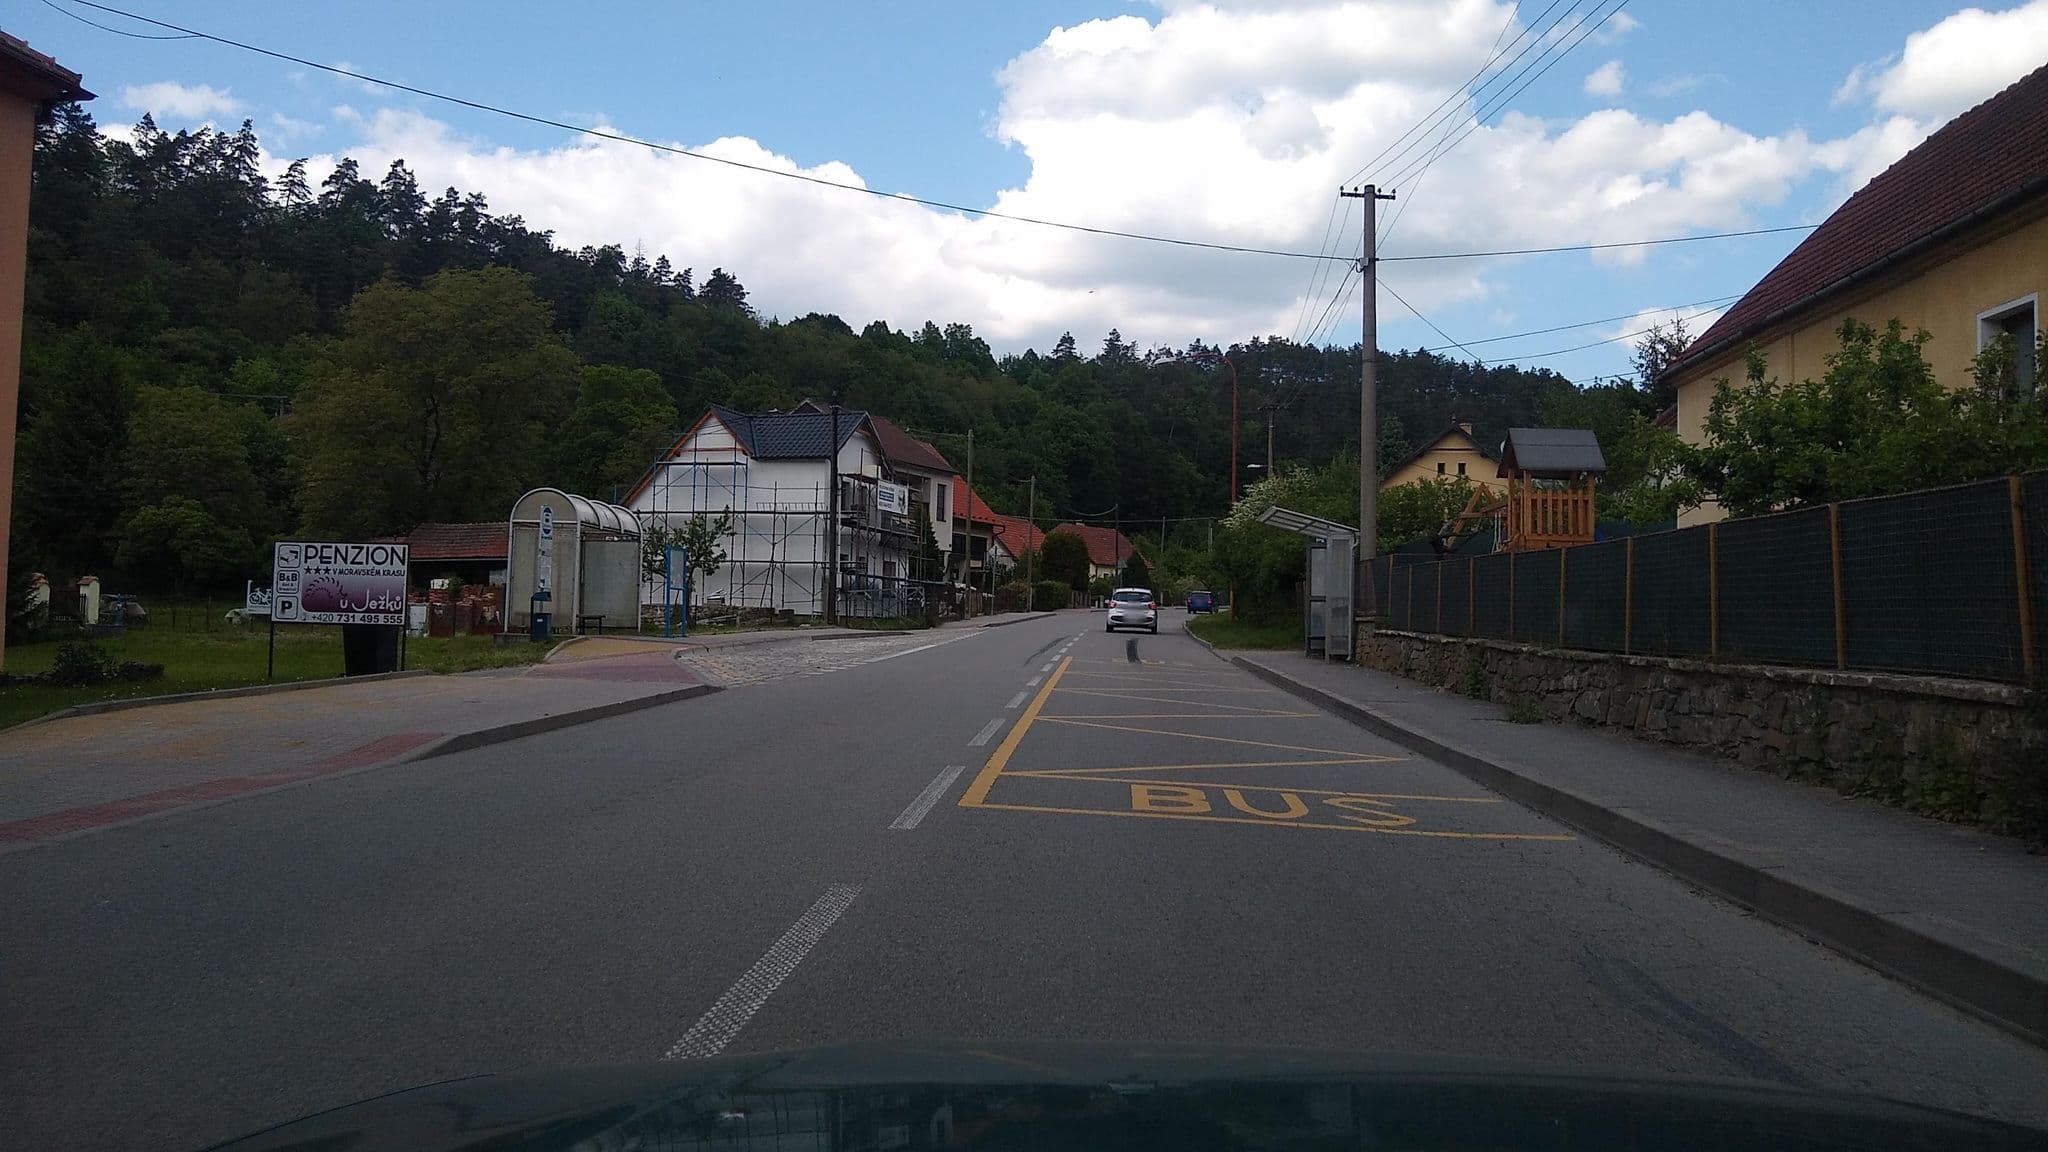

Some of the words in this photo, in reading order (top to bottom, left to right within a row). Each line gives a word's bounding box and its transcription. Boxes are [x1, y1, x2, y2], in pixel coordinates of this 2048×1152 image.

[304, 545, 406, 565] PENZION
[382, 569, 406, 577] KRASU
[281, 600, 293, 615] P
[351, 589, 402, 612] Ježků
[312, 613, 334, 623] +420
[336, 614, 356, 623] 731
[359, 614, 380, 624] 495
[383, 615, 403, 624] 555
[1130, 783, 1417, 827] BUS
